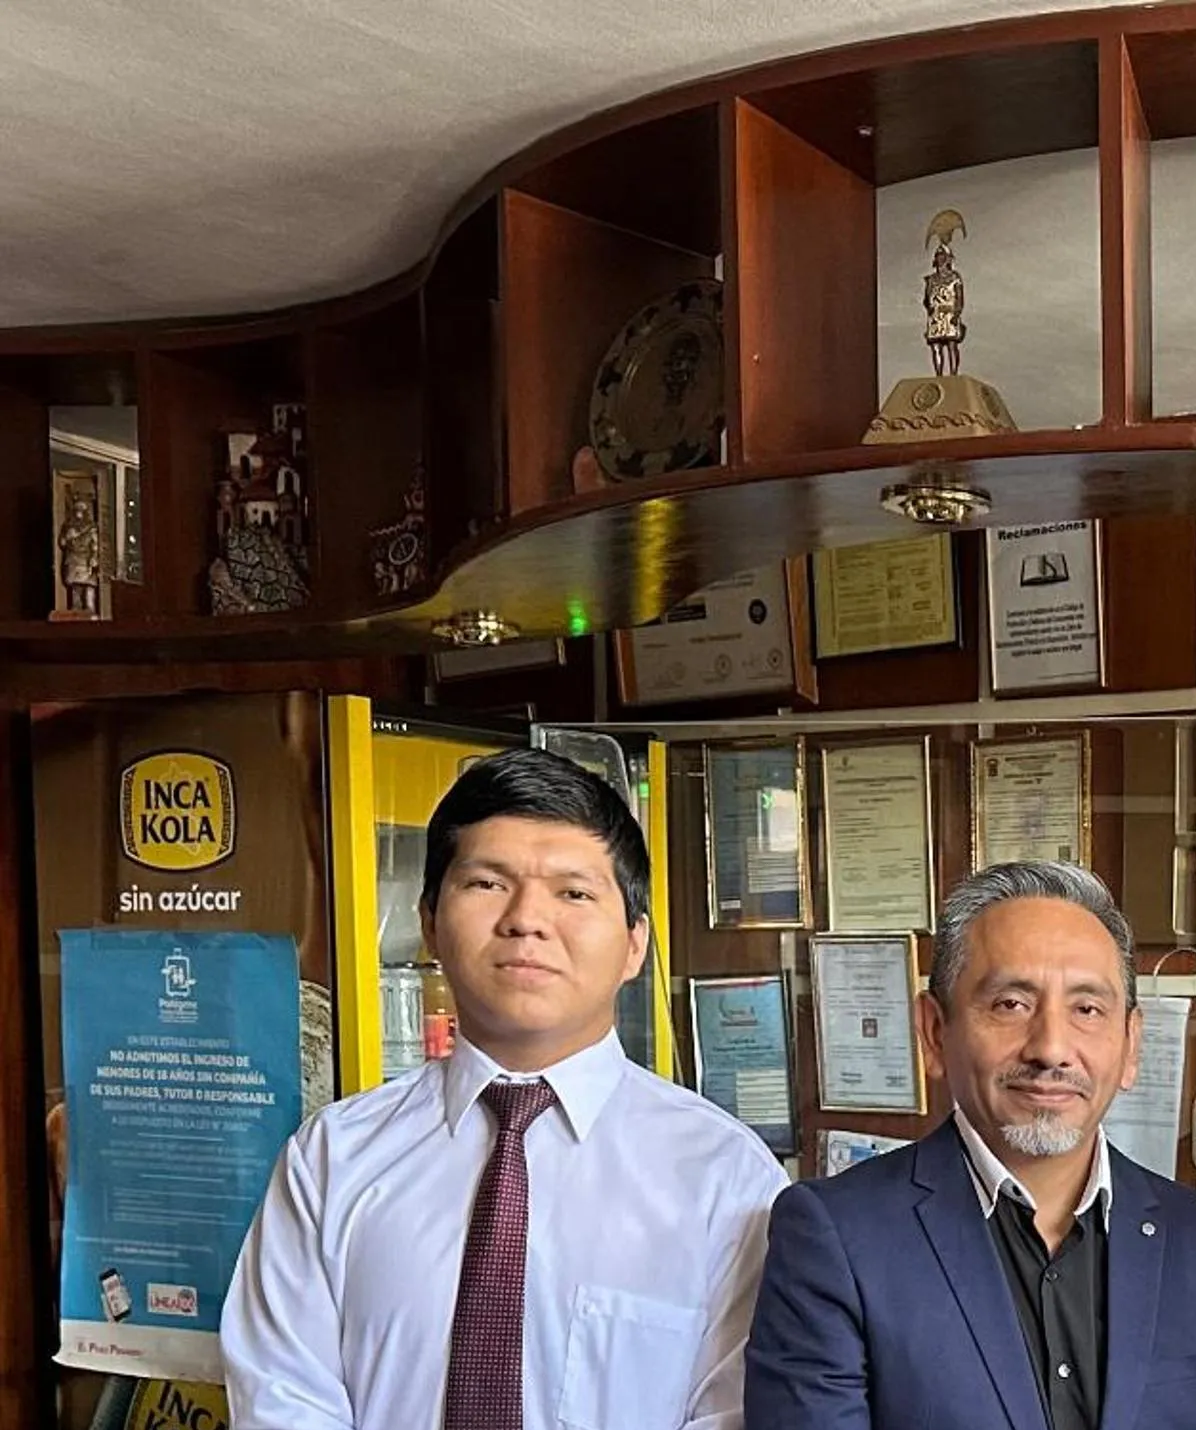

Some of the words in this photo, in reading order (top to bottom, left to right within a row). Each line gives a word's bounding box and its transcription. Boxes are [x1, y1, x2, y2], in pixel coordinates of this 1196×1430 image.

[998, 520, 1087, 541] Reclamaciones
[143, 779, 211, 810] INCA
[140, 814, 215, 844] KOLA
[120, 885, 153, 911] sin
[159, 883, 241, 911] azúcar
[110, 1050, 125, 1062] NO
[236, 1055, 250, 1067] DE
[142, 1068, 156, 1080] DE
[169, 1067, 195, 1082] AÑOS
[90, 1083, 102, 1096] DE
[163, 1087, 194, 1100] TUTOR
